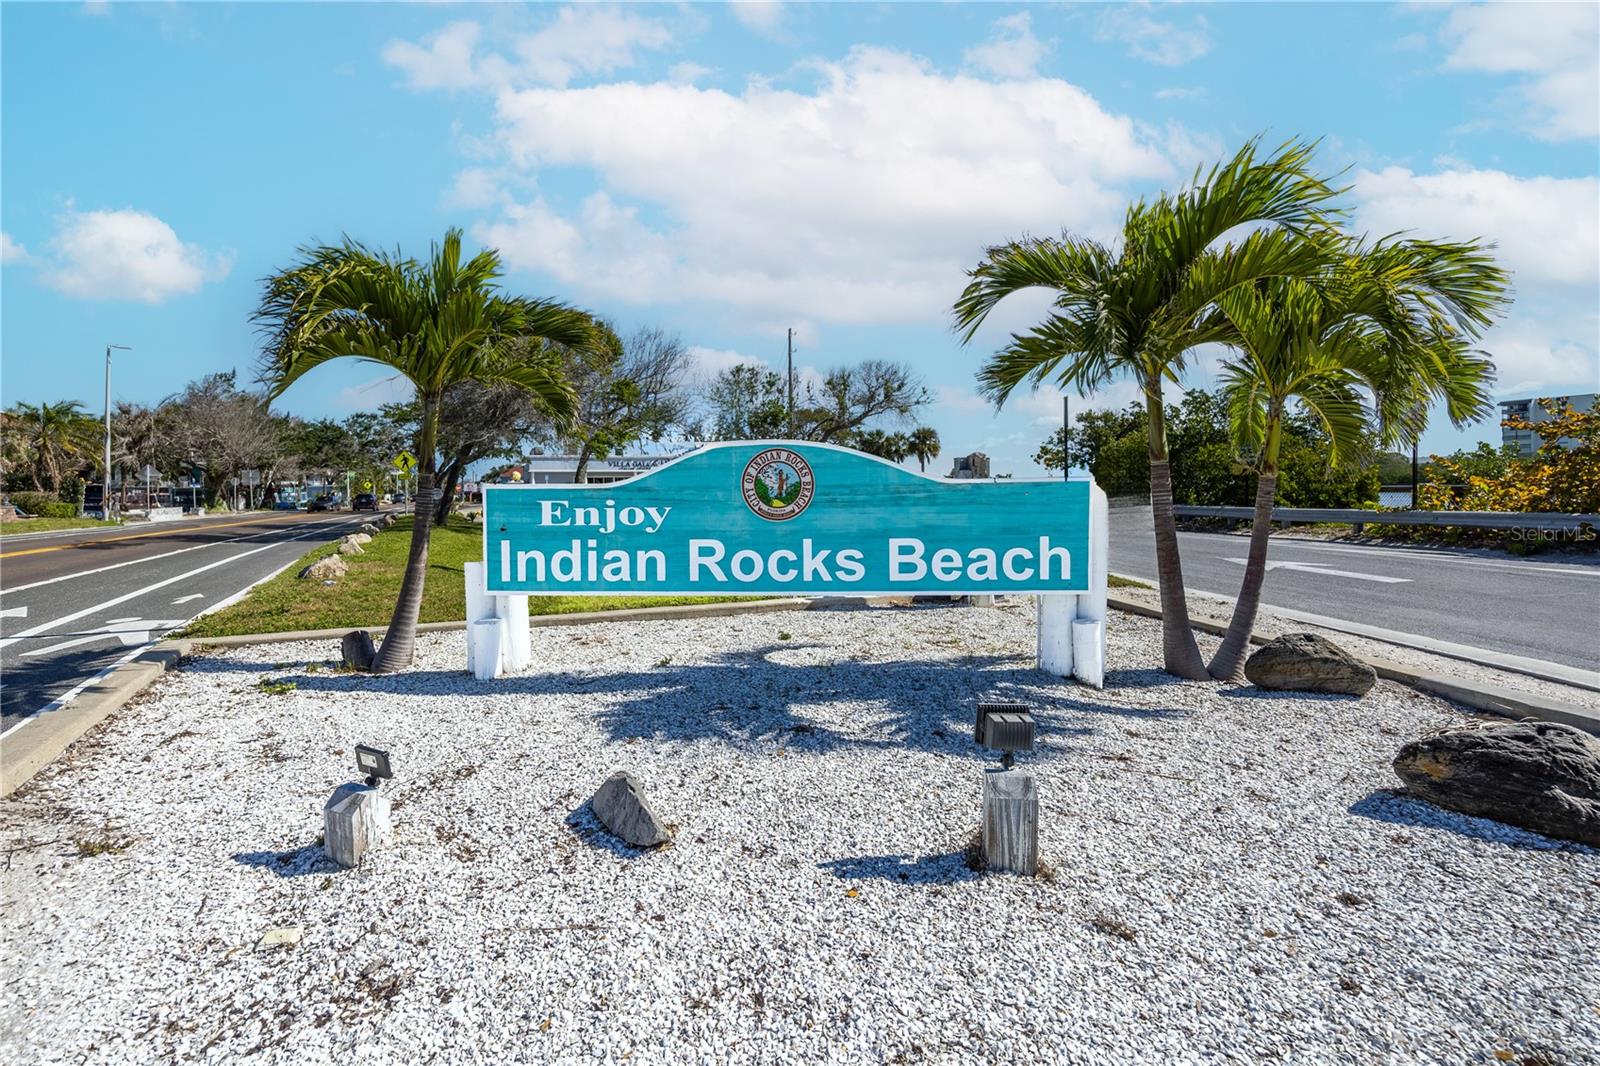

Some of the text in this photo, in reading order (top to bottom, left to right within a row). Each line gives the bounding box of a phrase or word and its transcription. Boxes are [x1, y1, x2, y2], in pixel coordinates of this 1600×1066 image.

[745, 451, 811, 510] CITY OF INDIAN ROCKS BEACH
[536, 499, 672, 534] Enjoy
[500, 536, 1072, 583] Indian Rocks Beach
